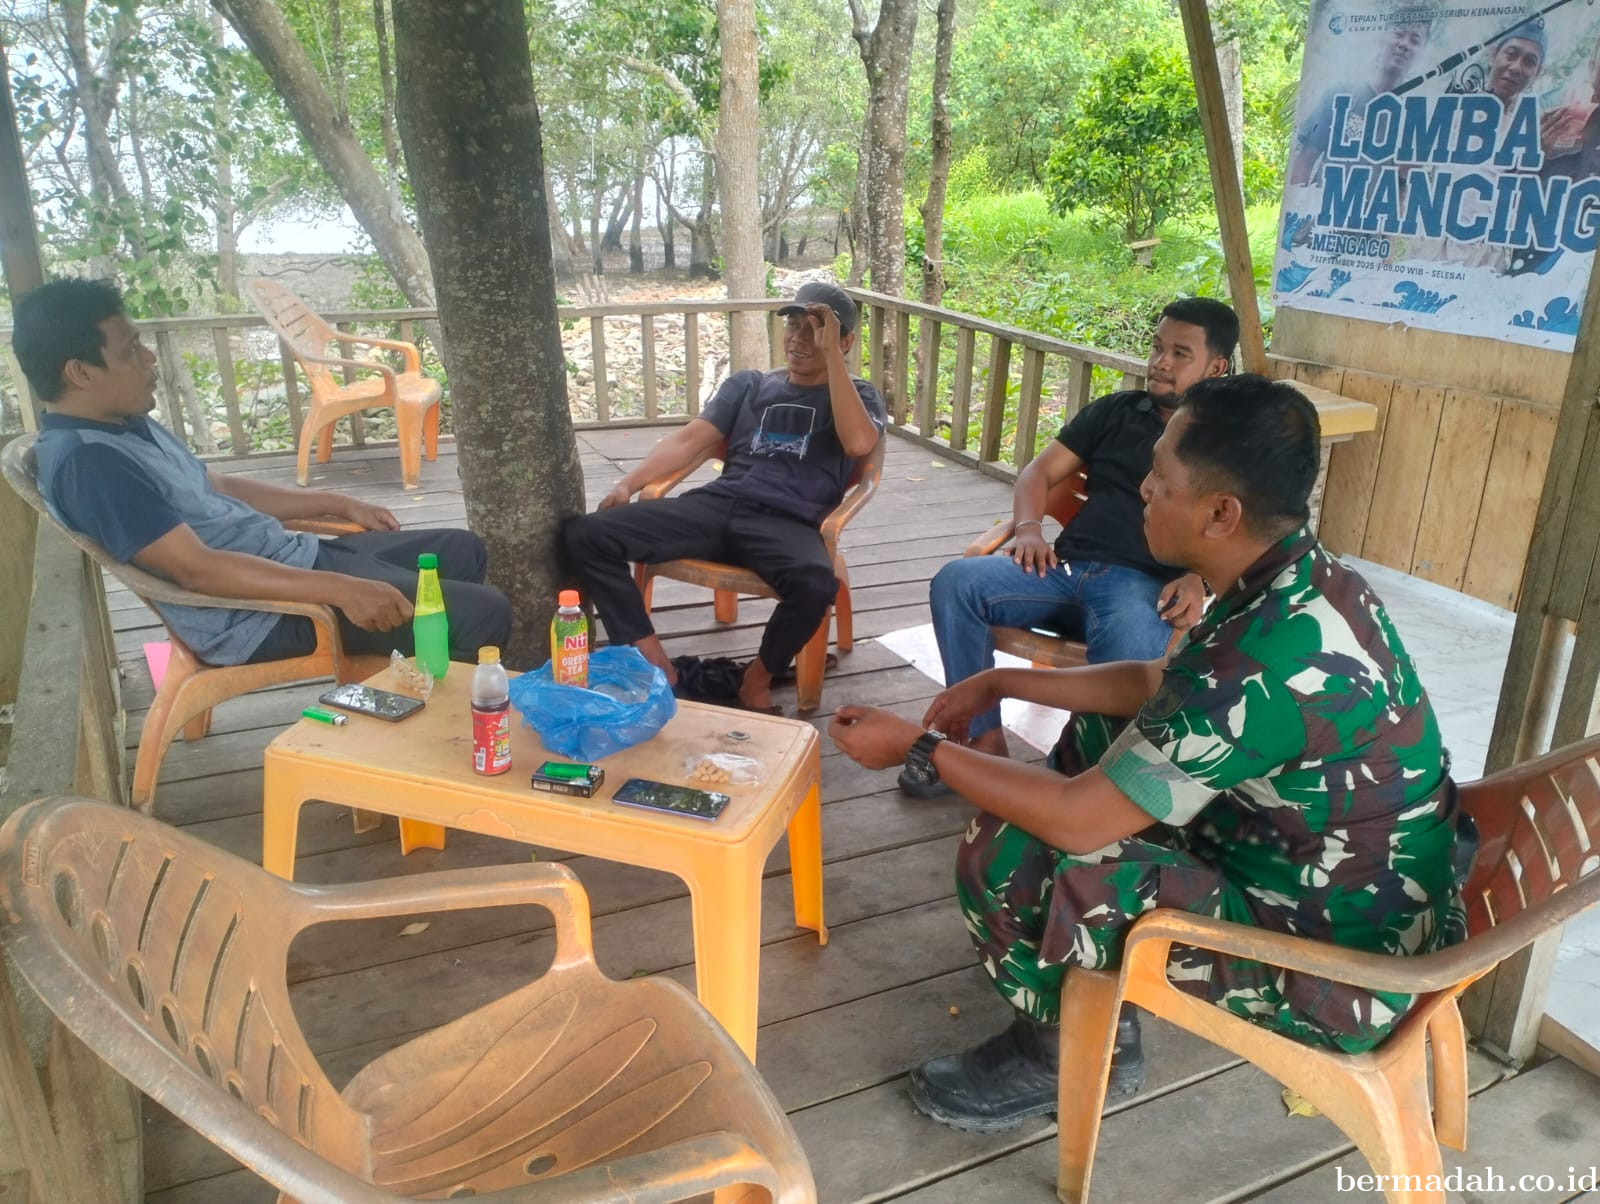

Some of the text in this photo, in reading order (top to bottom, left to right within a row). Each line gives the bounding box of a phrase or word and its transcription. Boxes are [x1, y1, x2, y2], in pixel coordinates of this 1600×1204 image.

[1349, 15, 1378, 23] TEPIAN
[1440, 8, 1470, 18] SERIBU
[1470, 6, 1526, 17] KENANGAN
[1329, 94, 1543, 170] LOMBA
[1317, 165, 1600, 252] MANCING
[1312, 233, 1391, 259] MENGACO
[1314, 255, 1356, 268] SEPTEMBER
[1355, 260, 1376, 270] 2025
[1407, 266, 1424, 276] WIB
[1431, 270, 1466, 281] SELESAI
[567, 664, 583, 675] TEA
